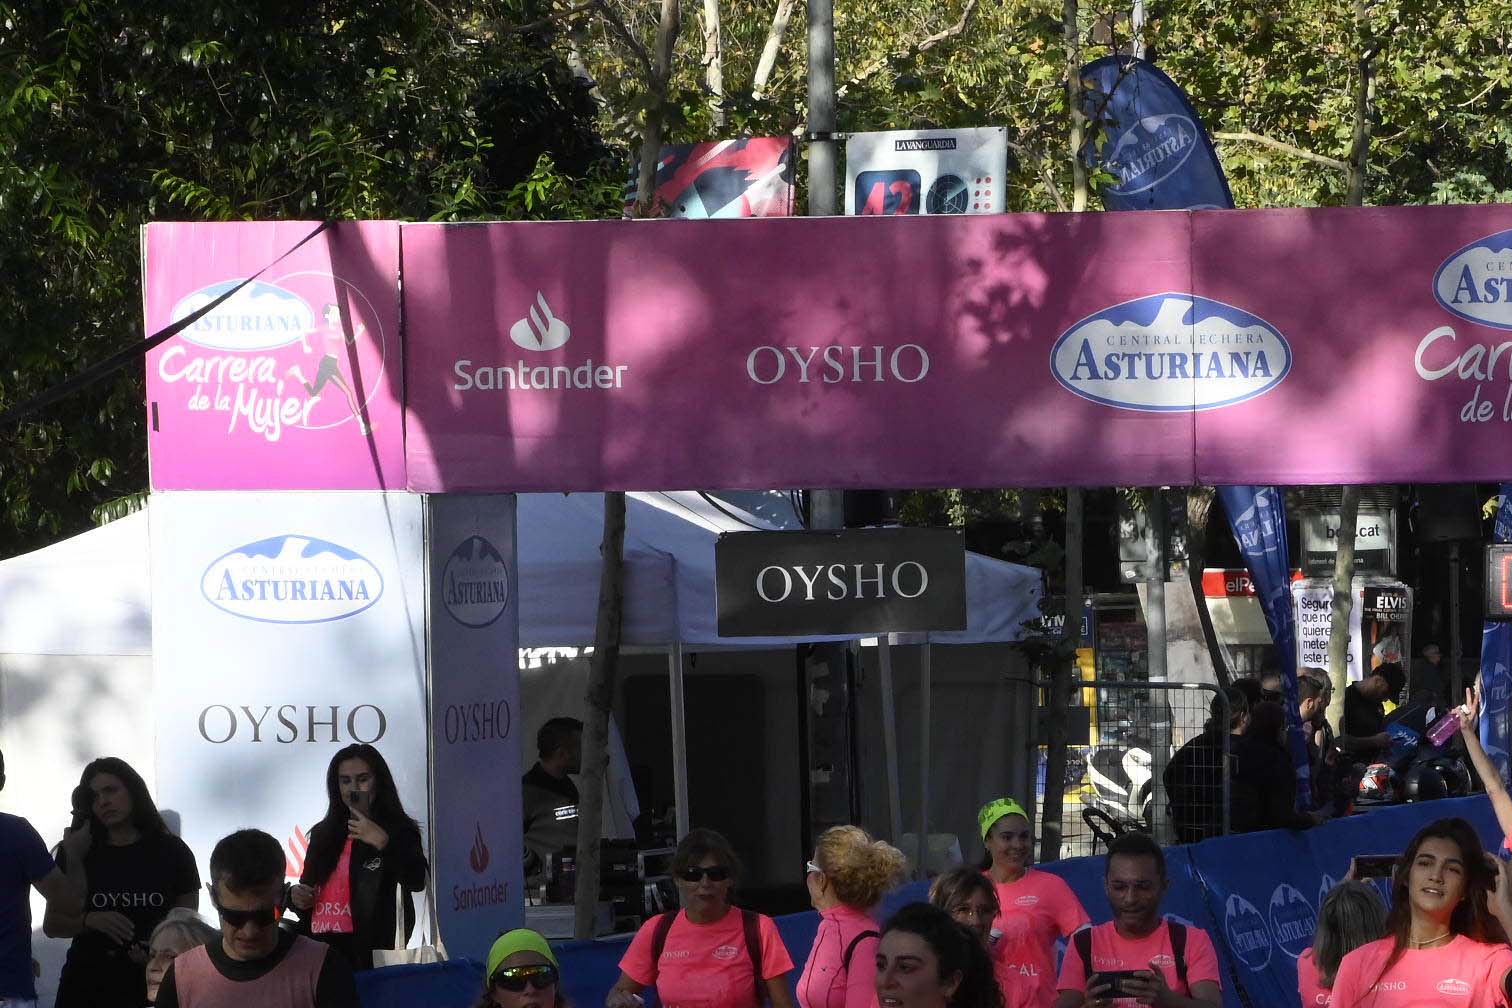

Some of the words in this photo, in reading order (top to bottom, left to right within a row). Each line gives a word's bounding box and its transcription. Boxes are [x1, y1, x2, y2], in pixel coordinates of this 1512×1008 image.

[907, 138, 956, 149] VANGUARDIA
[1106, 334, 1183, 348] CENTRAL
[1188, 331, 1265, 346] LECHERA
[158, 344, 277, 384] Carrera
[454, 360, 627, 391] Santander
[746, 343, 931, 385] OYSHO
[1069, 338, 1273, 382] ASTURIANA
[188, 385, 210, 411] de
[214, 383, 231, 411] la
[228, 381, 322, 442] Mujer
[1460, 386, 1494, 424] de
[216, 568, 371, 602] ASTURIANA
[447, 573, 506, 606] ASTURIANA
[756, 560, 929, 604] OYSHO
[1376, 596, 1407, 609] ELVIS
[1302, 614, 1318, 626] que
[1303, 653, 1321, 664] este
[199, 704, 388, 744] OYSHO
[445, 700, 511, 745] OYSHO
[92, 891, 164, 908] OYSHO
[453, 881, 510, 912] Santander
